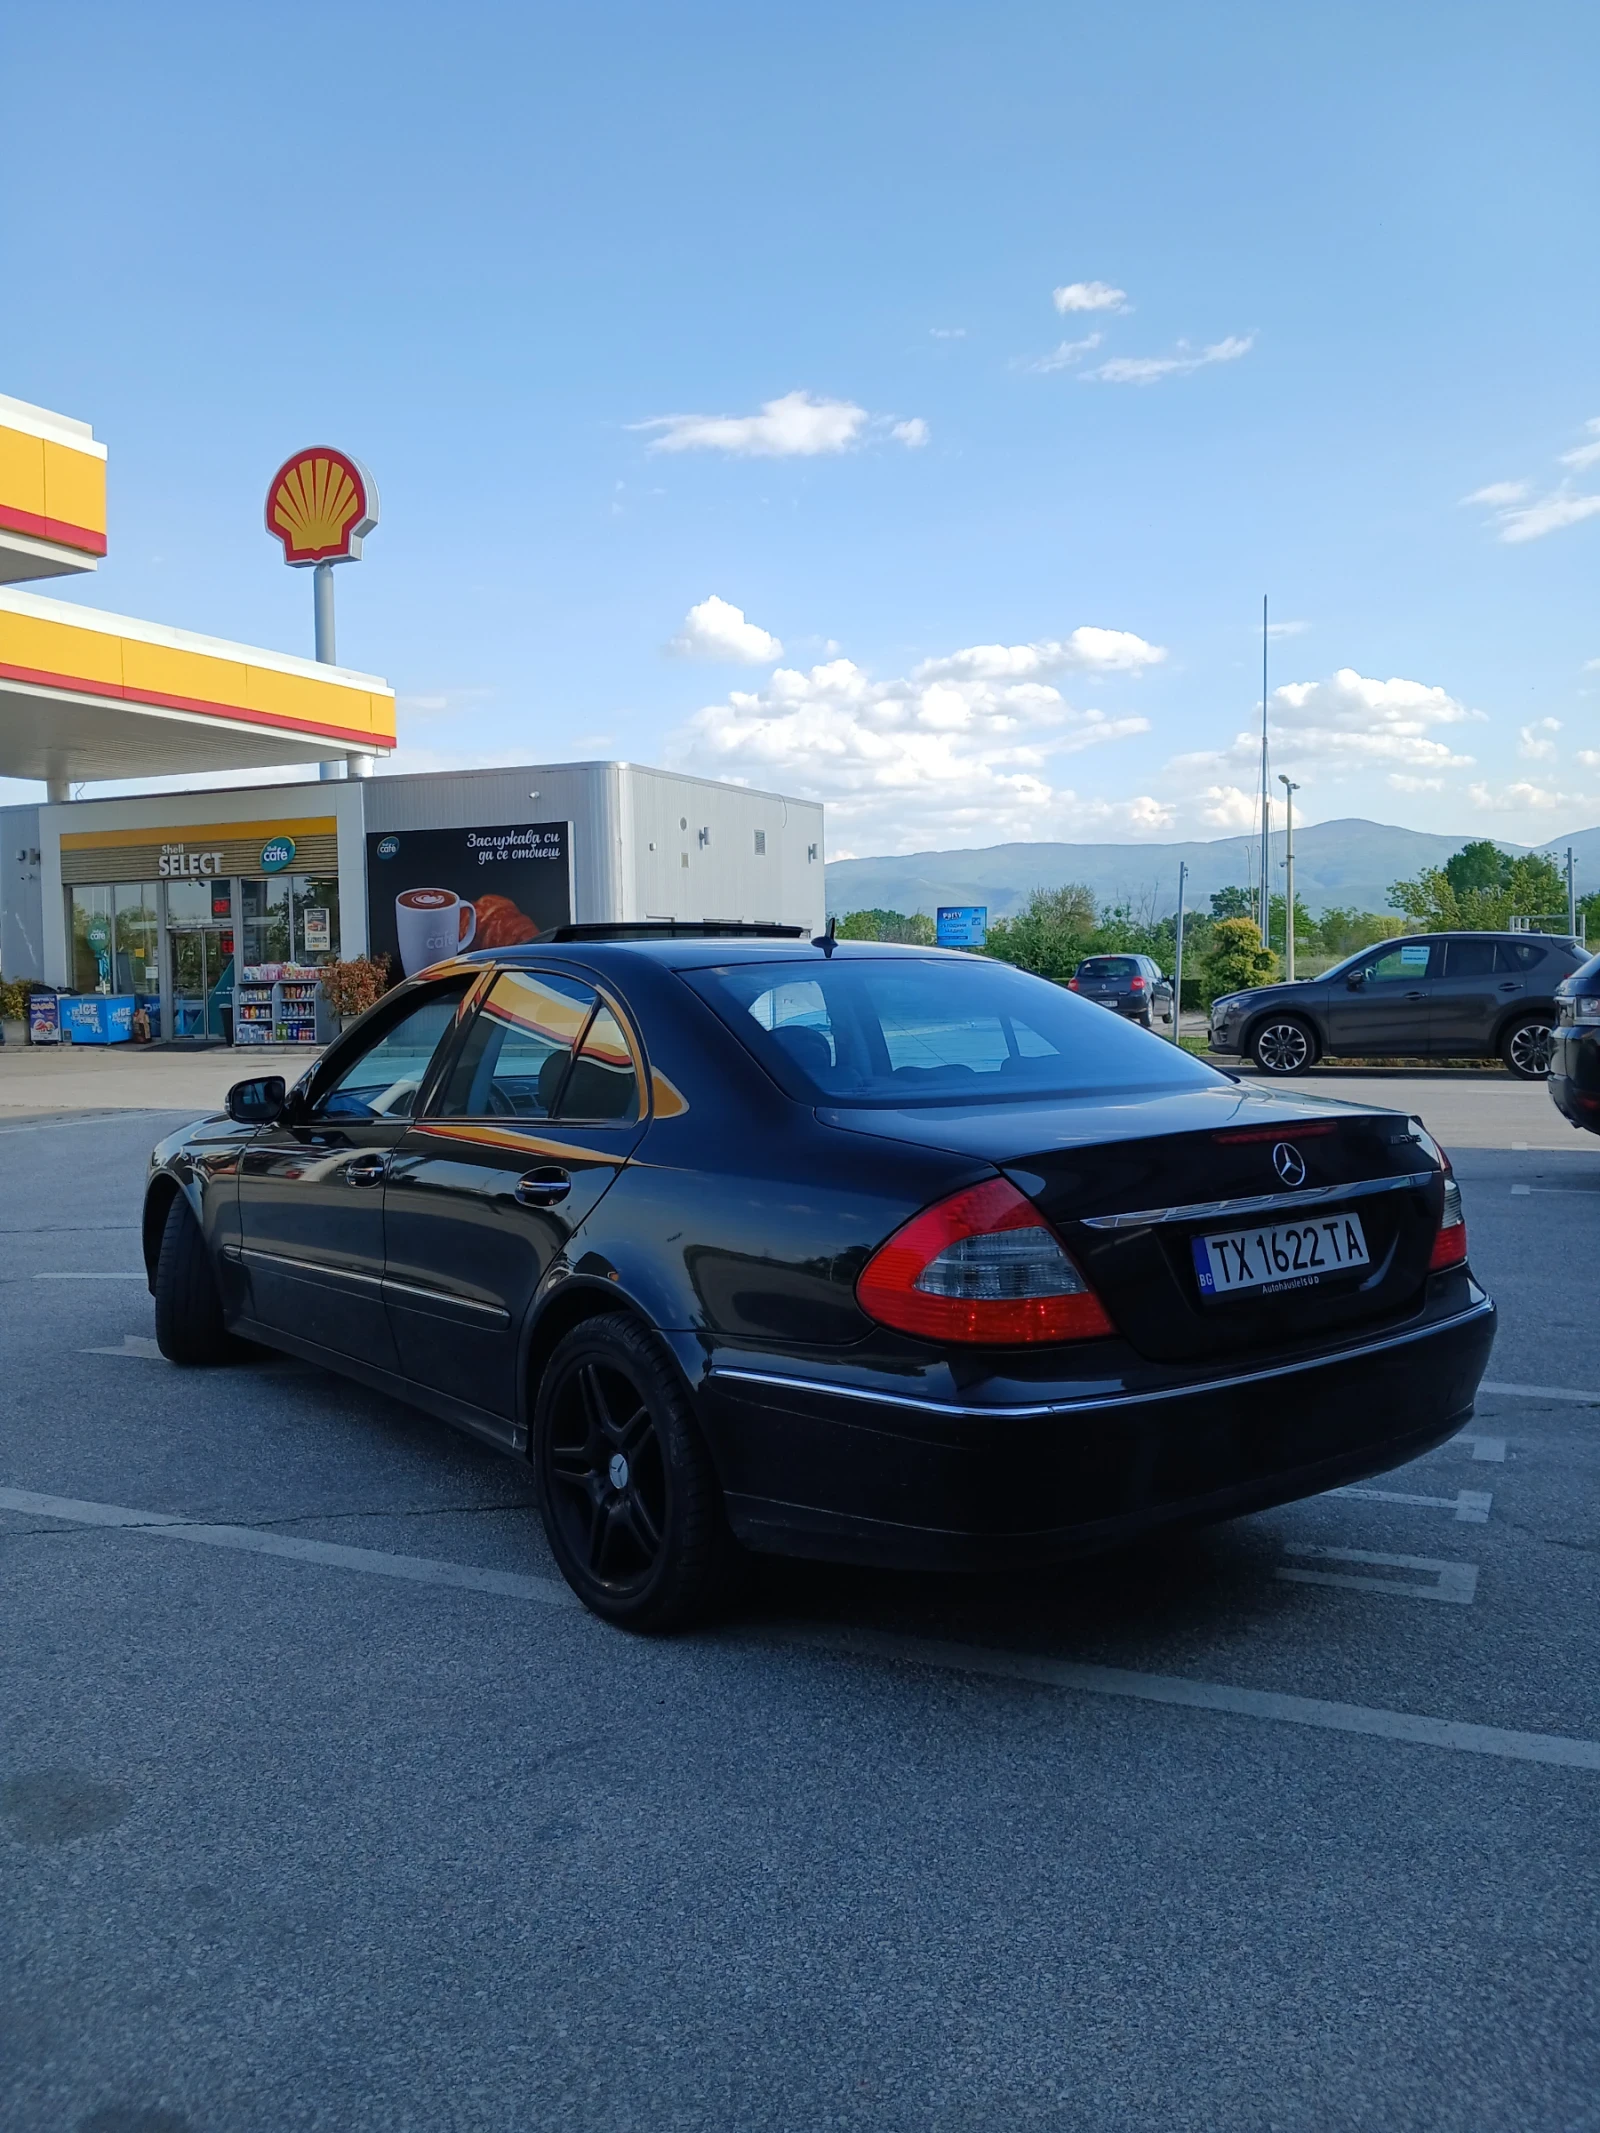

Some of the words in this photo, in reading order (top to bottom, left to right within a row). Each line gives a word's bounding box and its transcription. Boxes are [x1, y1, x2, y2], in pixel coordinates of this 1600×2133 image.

[466, 829, 542, 850] Заслужава
[543, 832, 561, 843] си
[161, 843, 184, 855] Shell
[263, 847, 288, 862] café
[478, 850, 494, 865] да
[496, 849, 509, 860] се
[511, 844, 561, 860] отбиеш
[158, 852, 224, 876] SELECT
[79, 1003, 98, 1015] ICE
[117, 1007, 131, 1017] ICE
[1211, 1237, 1255, 1284] TX
[1256, 1226, 1326, 1276] 1622
[1322, 1219, 1364, 1263] TA
[1199, 1273, 1213, 1287] BG
